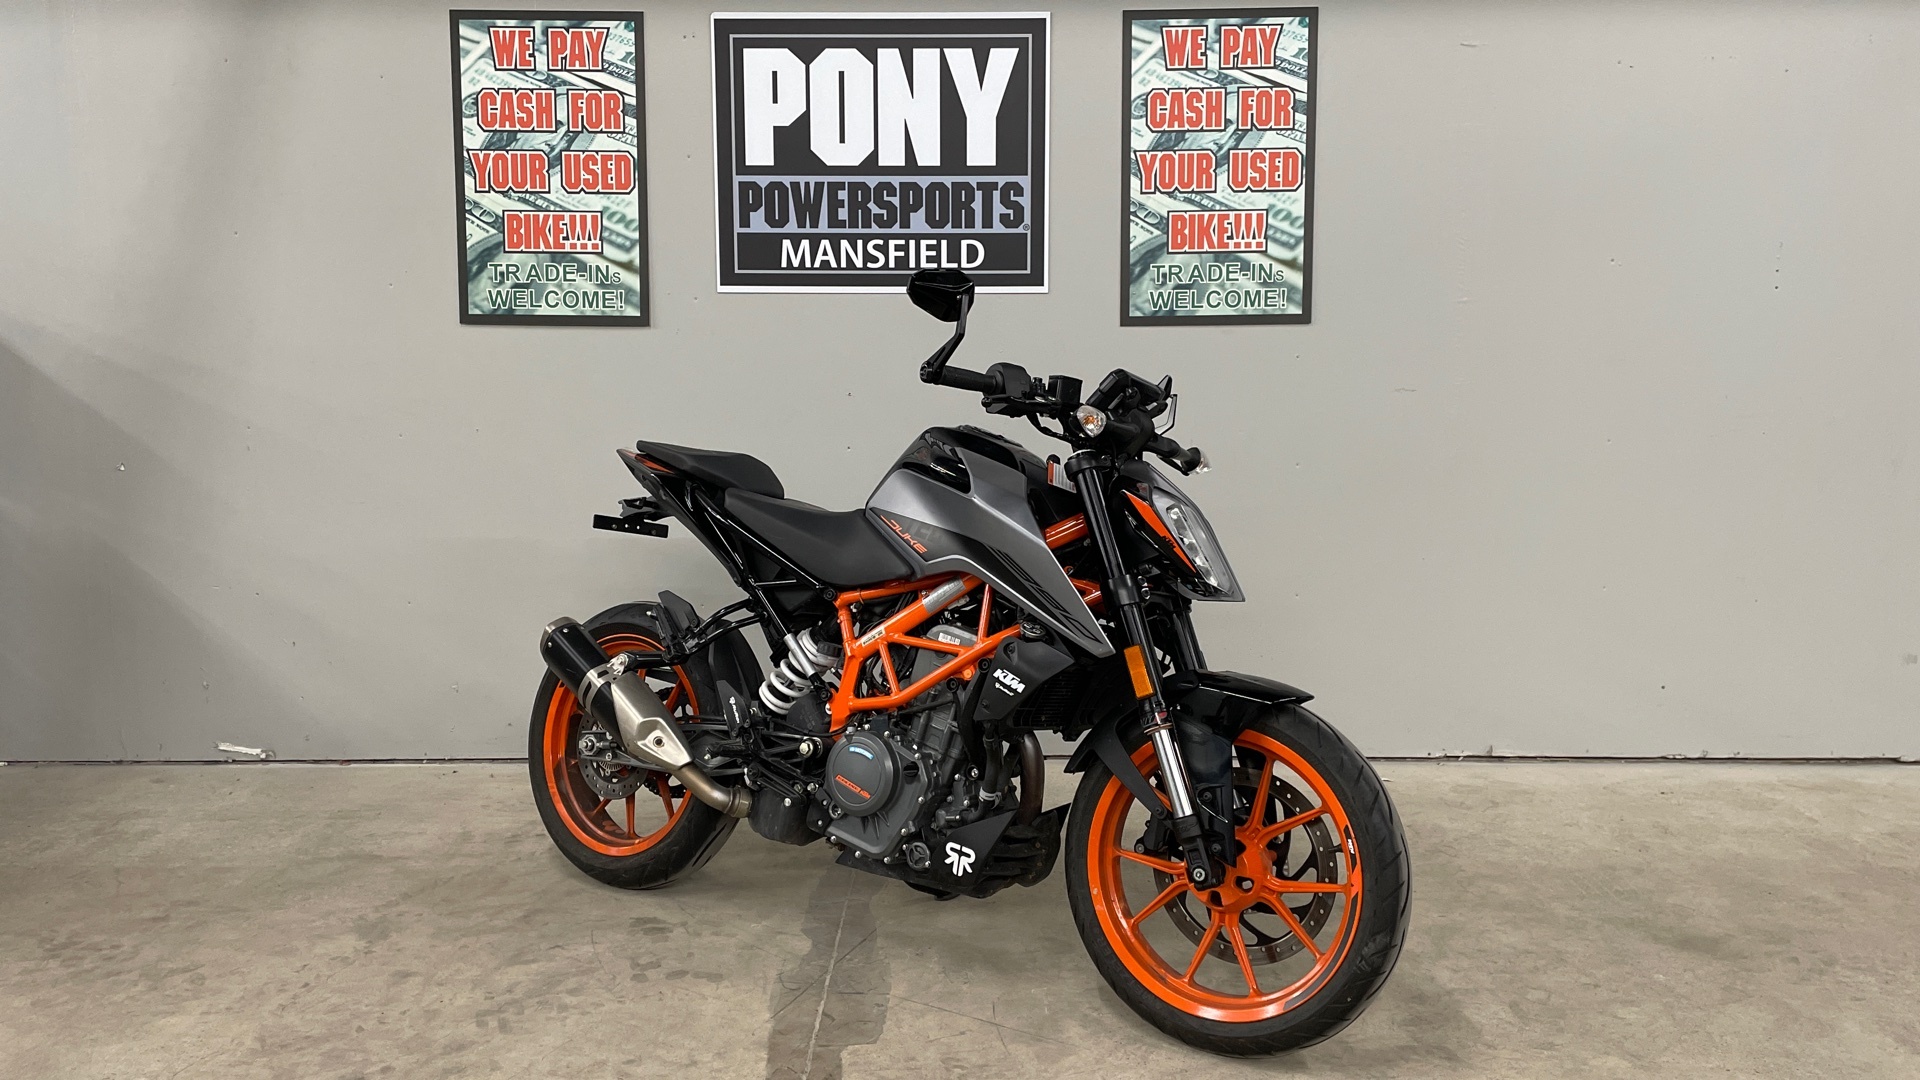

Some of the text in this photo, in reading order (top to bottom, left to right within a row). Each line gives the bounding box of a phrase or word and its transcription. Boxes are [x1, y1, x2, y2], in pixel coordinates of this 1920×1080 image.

[488, 26, 609, 71] WE PAY
[1161, 24, 1282, 71] WE PAY
[477, 88, 625, 132] CASH FOR
[743, 48, 1020, 166] PONY
[1146, 87, 1226, 132] CASH
[1237, 87, 1296, 131] FOR
[467, 149, 636, 194] YOUR USED
[1135, 148, 1303, 193] YOUR USED
[503, 210, 603, 253] BIKE!!!
[1167, 209, 1268, 254] BIKE!!!
[781, 239, 986, 269] MANSFIELD
[487, 288, 626, 310] WELCOME!
[1150, 289, 1287, 311] WELCOME!
[880, 515, 928, 554] DUKE
[993, 668, 1026, 693] KTM
